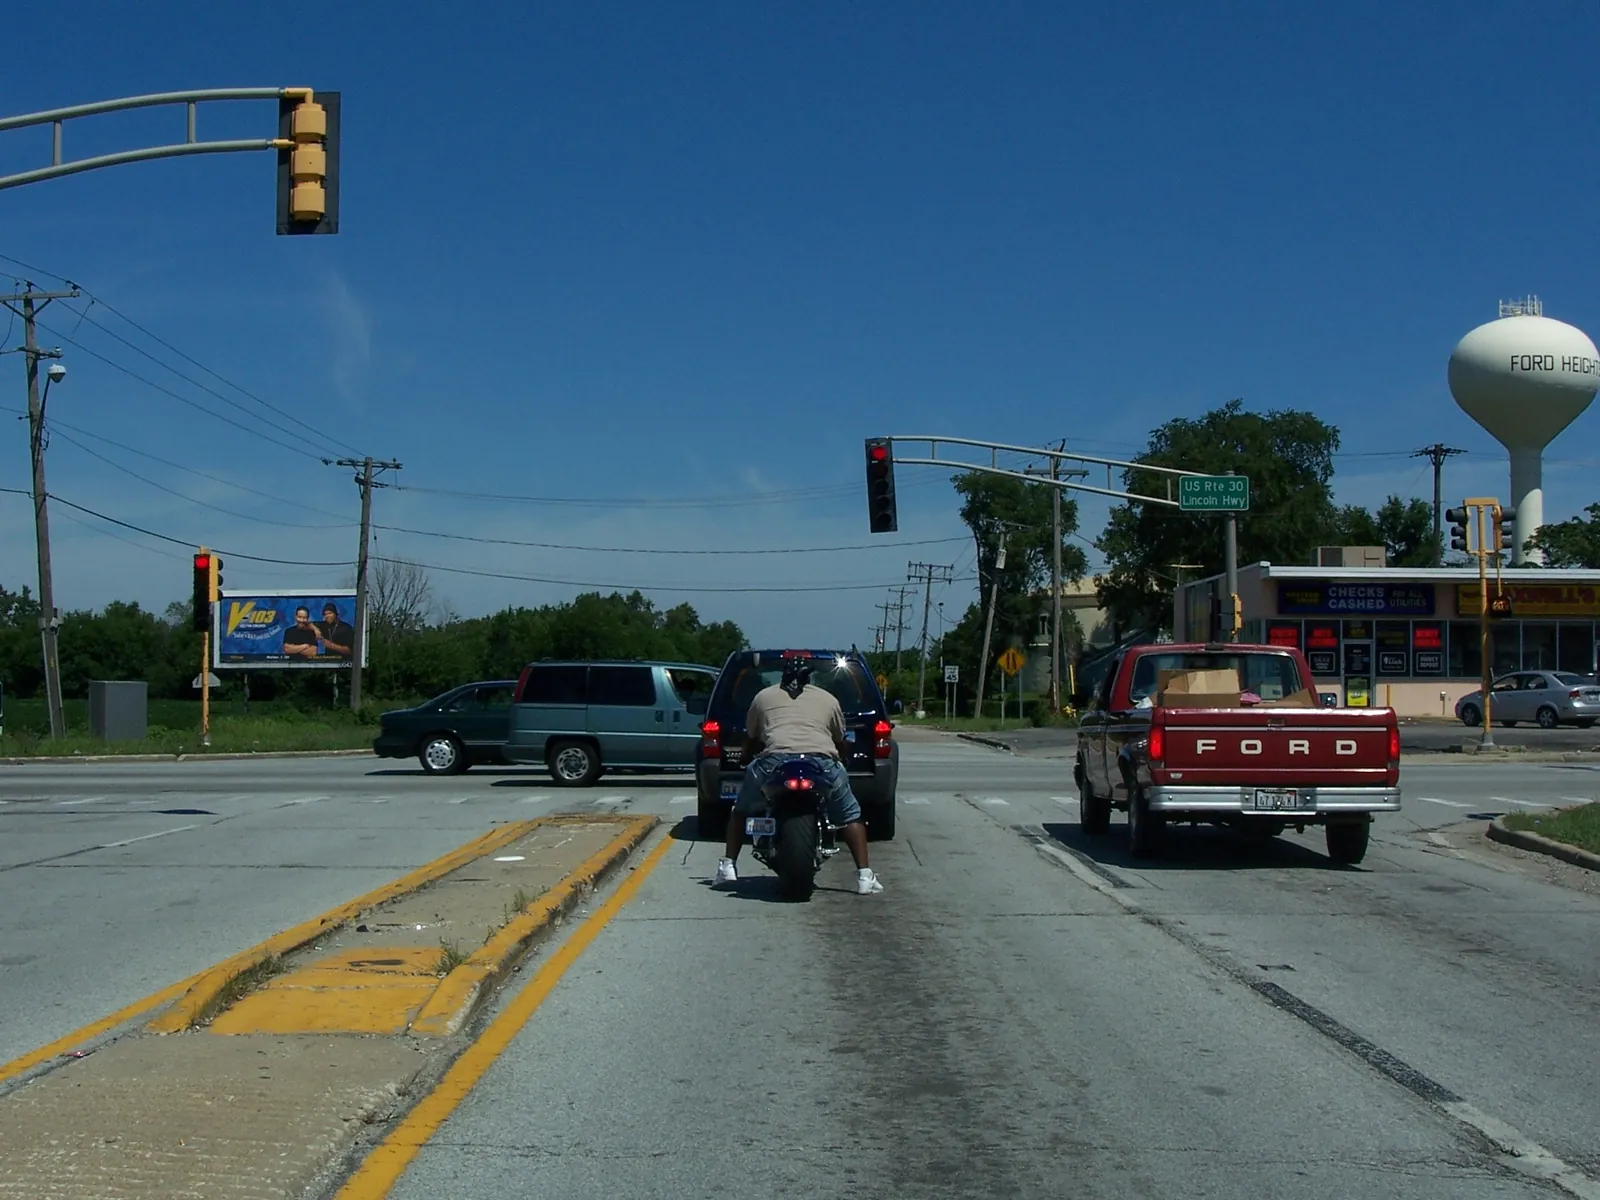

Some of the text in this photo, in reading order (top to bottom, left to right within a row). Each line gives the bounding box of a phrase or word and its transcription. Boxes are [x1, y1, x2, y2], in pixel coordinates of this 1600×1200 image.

[1510, 354, 1554, 371] FORD
[1184, 481, 1243, 491] US Rte 30
[1182, 495, 1245, 508] Lincoln Hwy
[1328, 586, 1385, 598] CHECKS
[1328, 599, 1385, 609] CASHED
[1196, 739, 1357, 755] FORD
